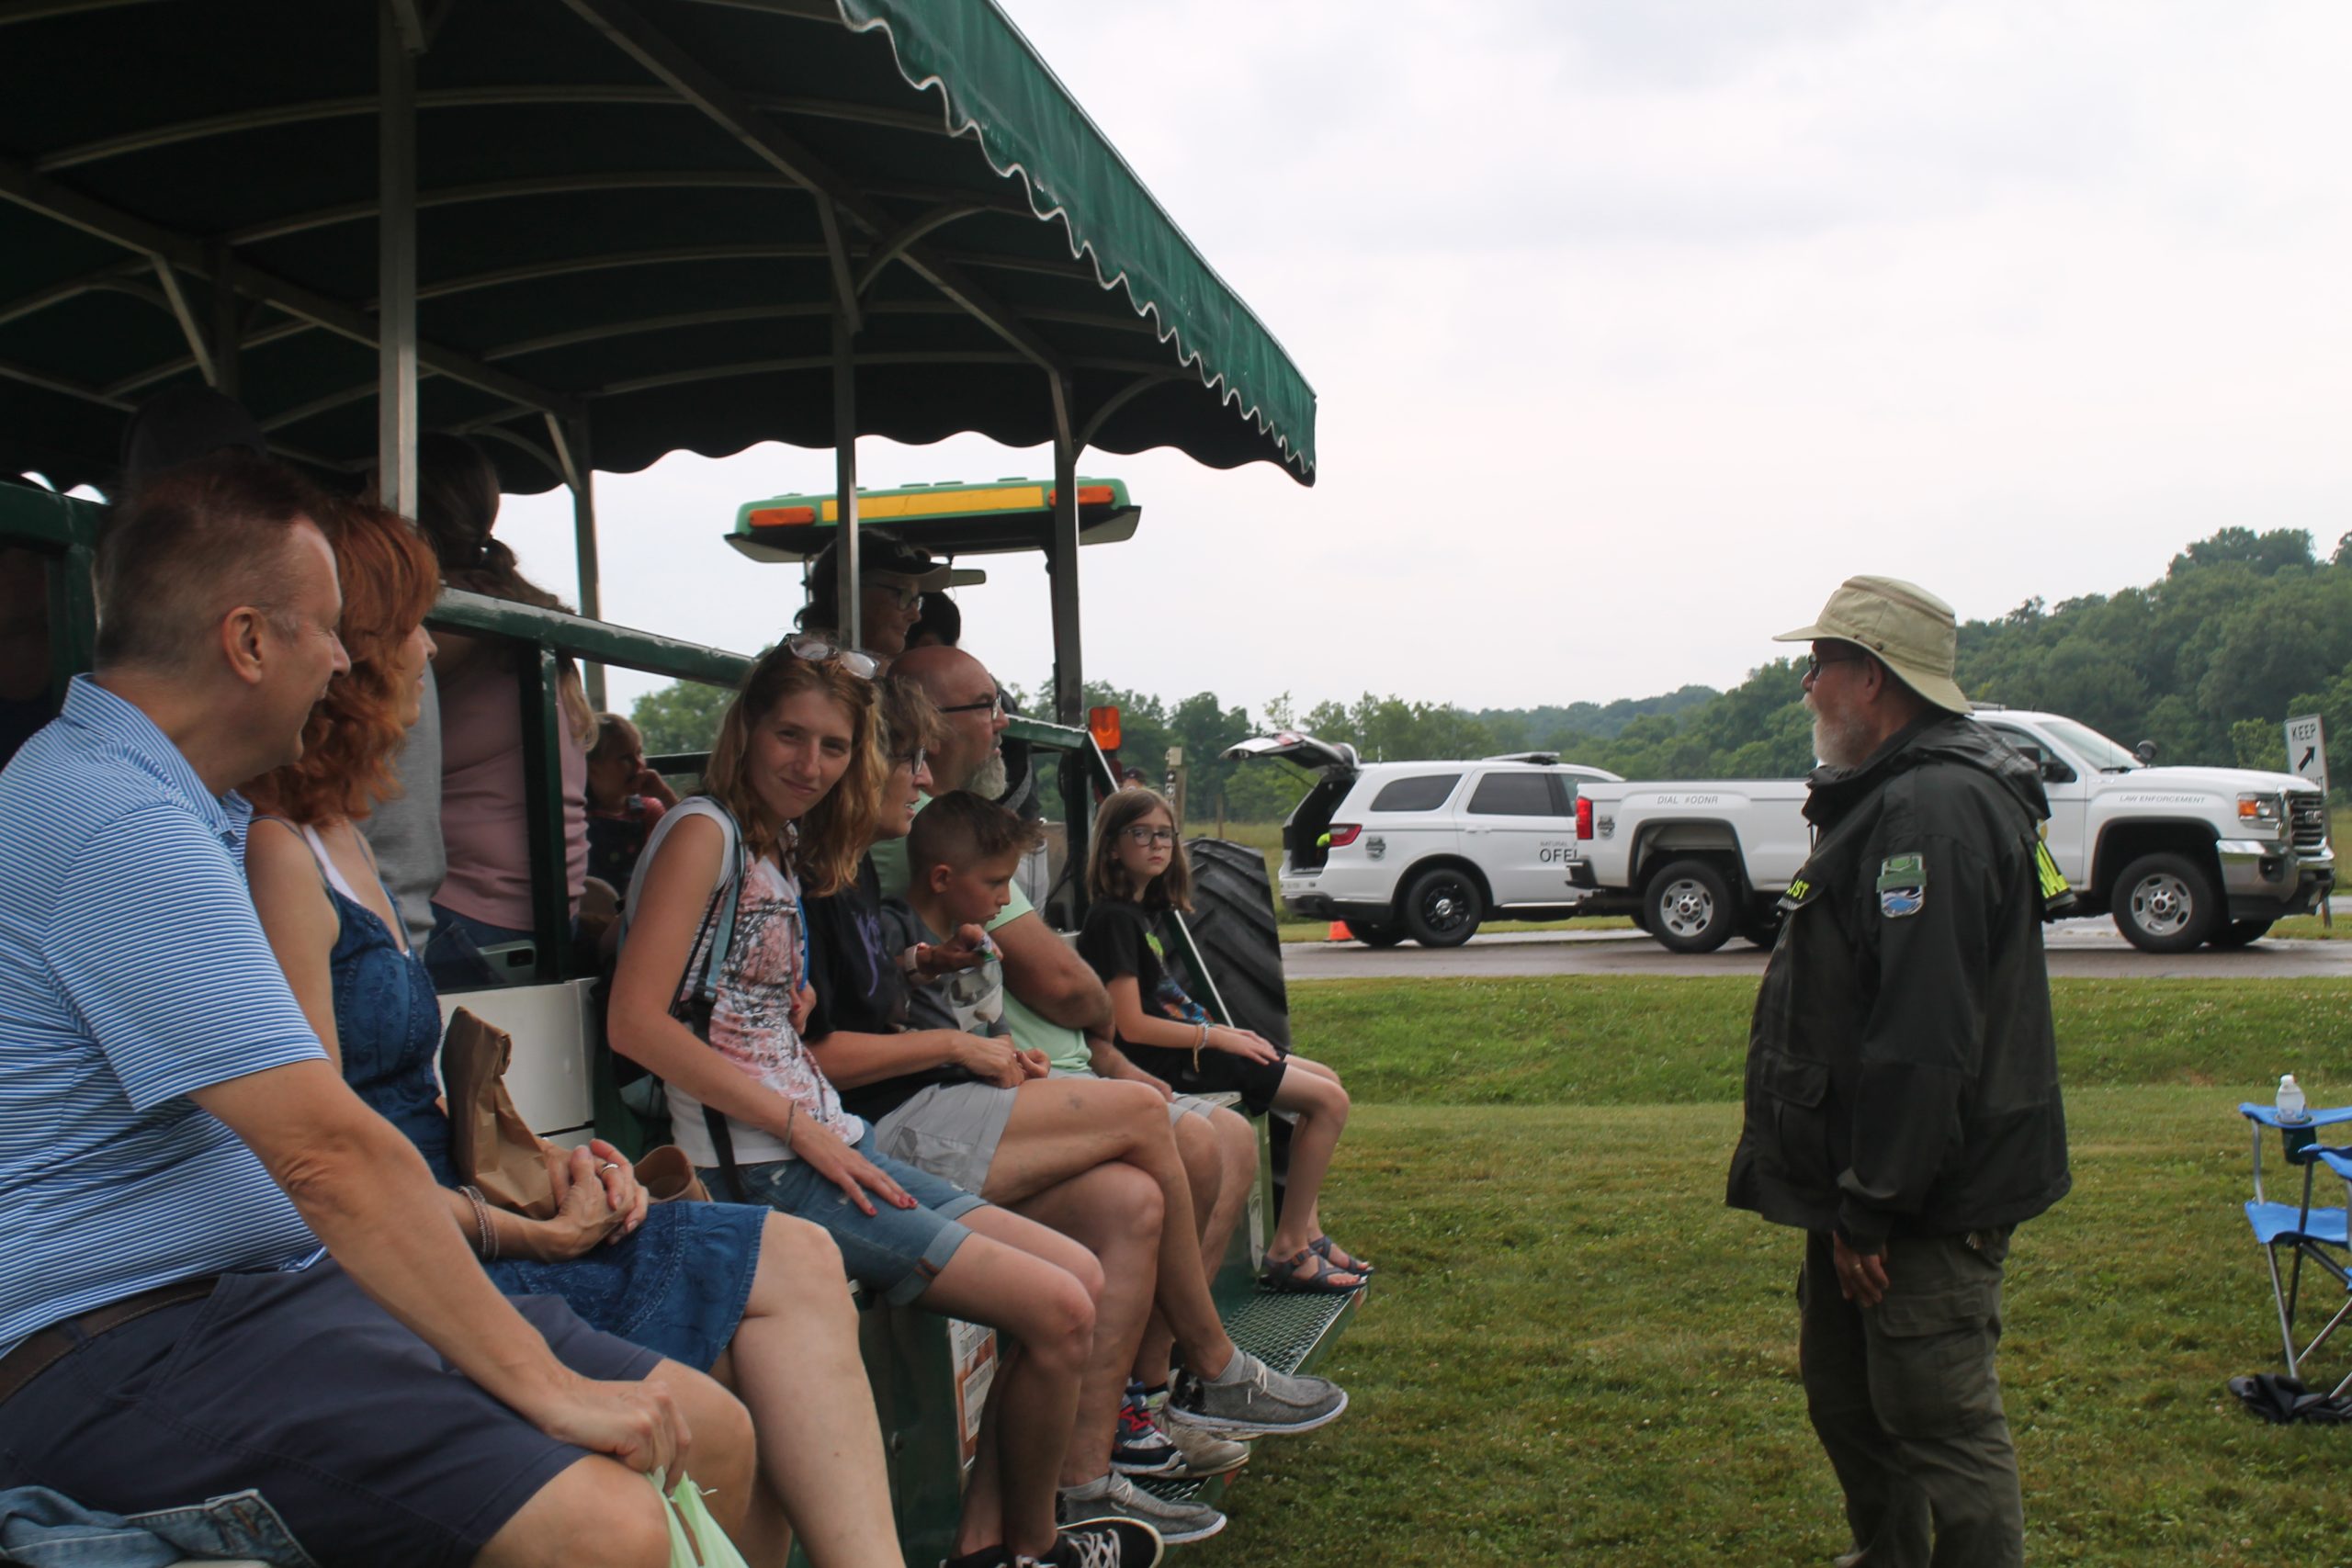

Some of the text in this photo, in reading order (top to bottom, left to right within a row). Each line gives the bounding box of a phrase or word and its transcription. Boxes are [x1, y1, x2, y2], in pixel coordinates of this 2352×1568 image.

[2291, 723, 2316, 742] KEEP
[1657, 795, 1679, 805] DIAL
[2139, 795, 2205, 804] ENFORCEMENT
